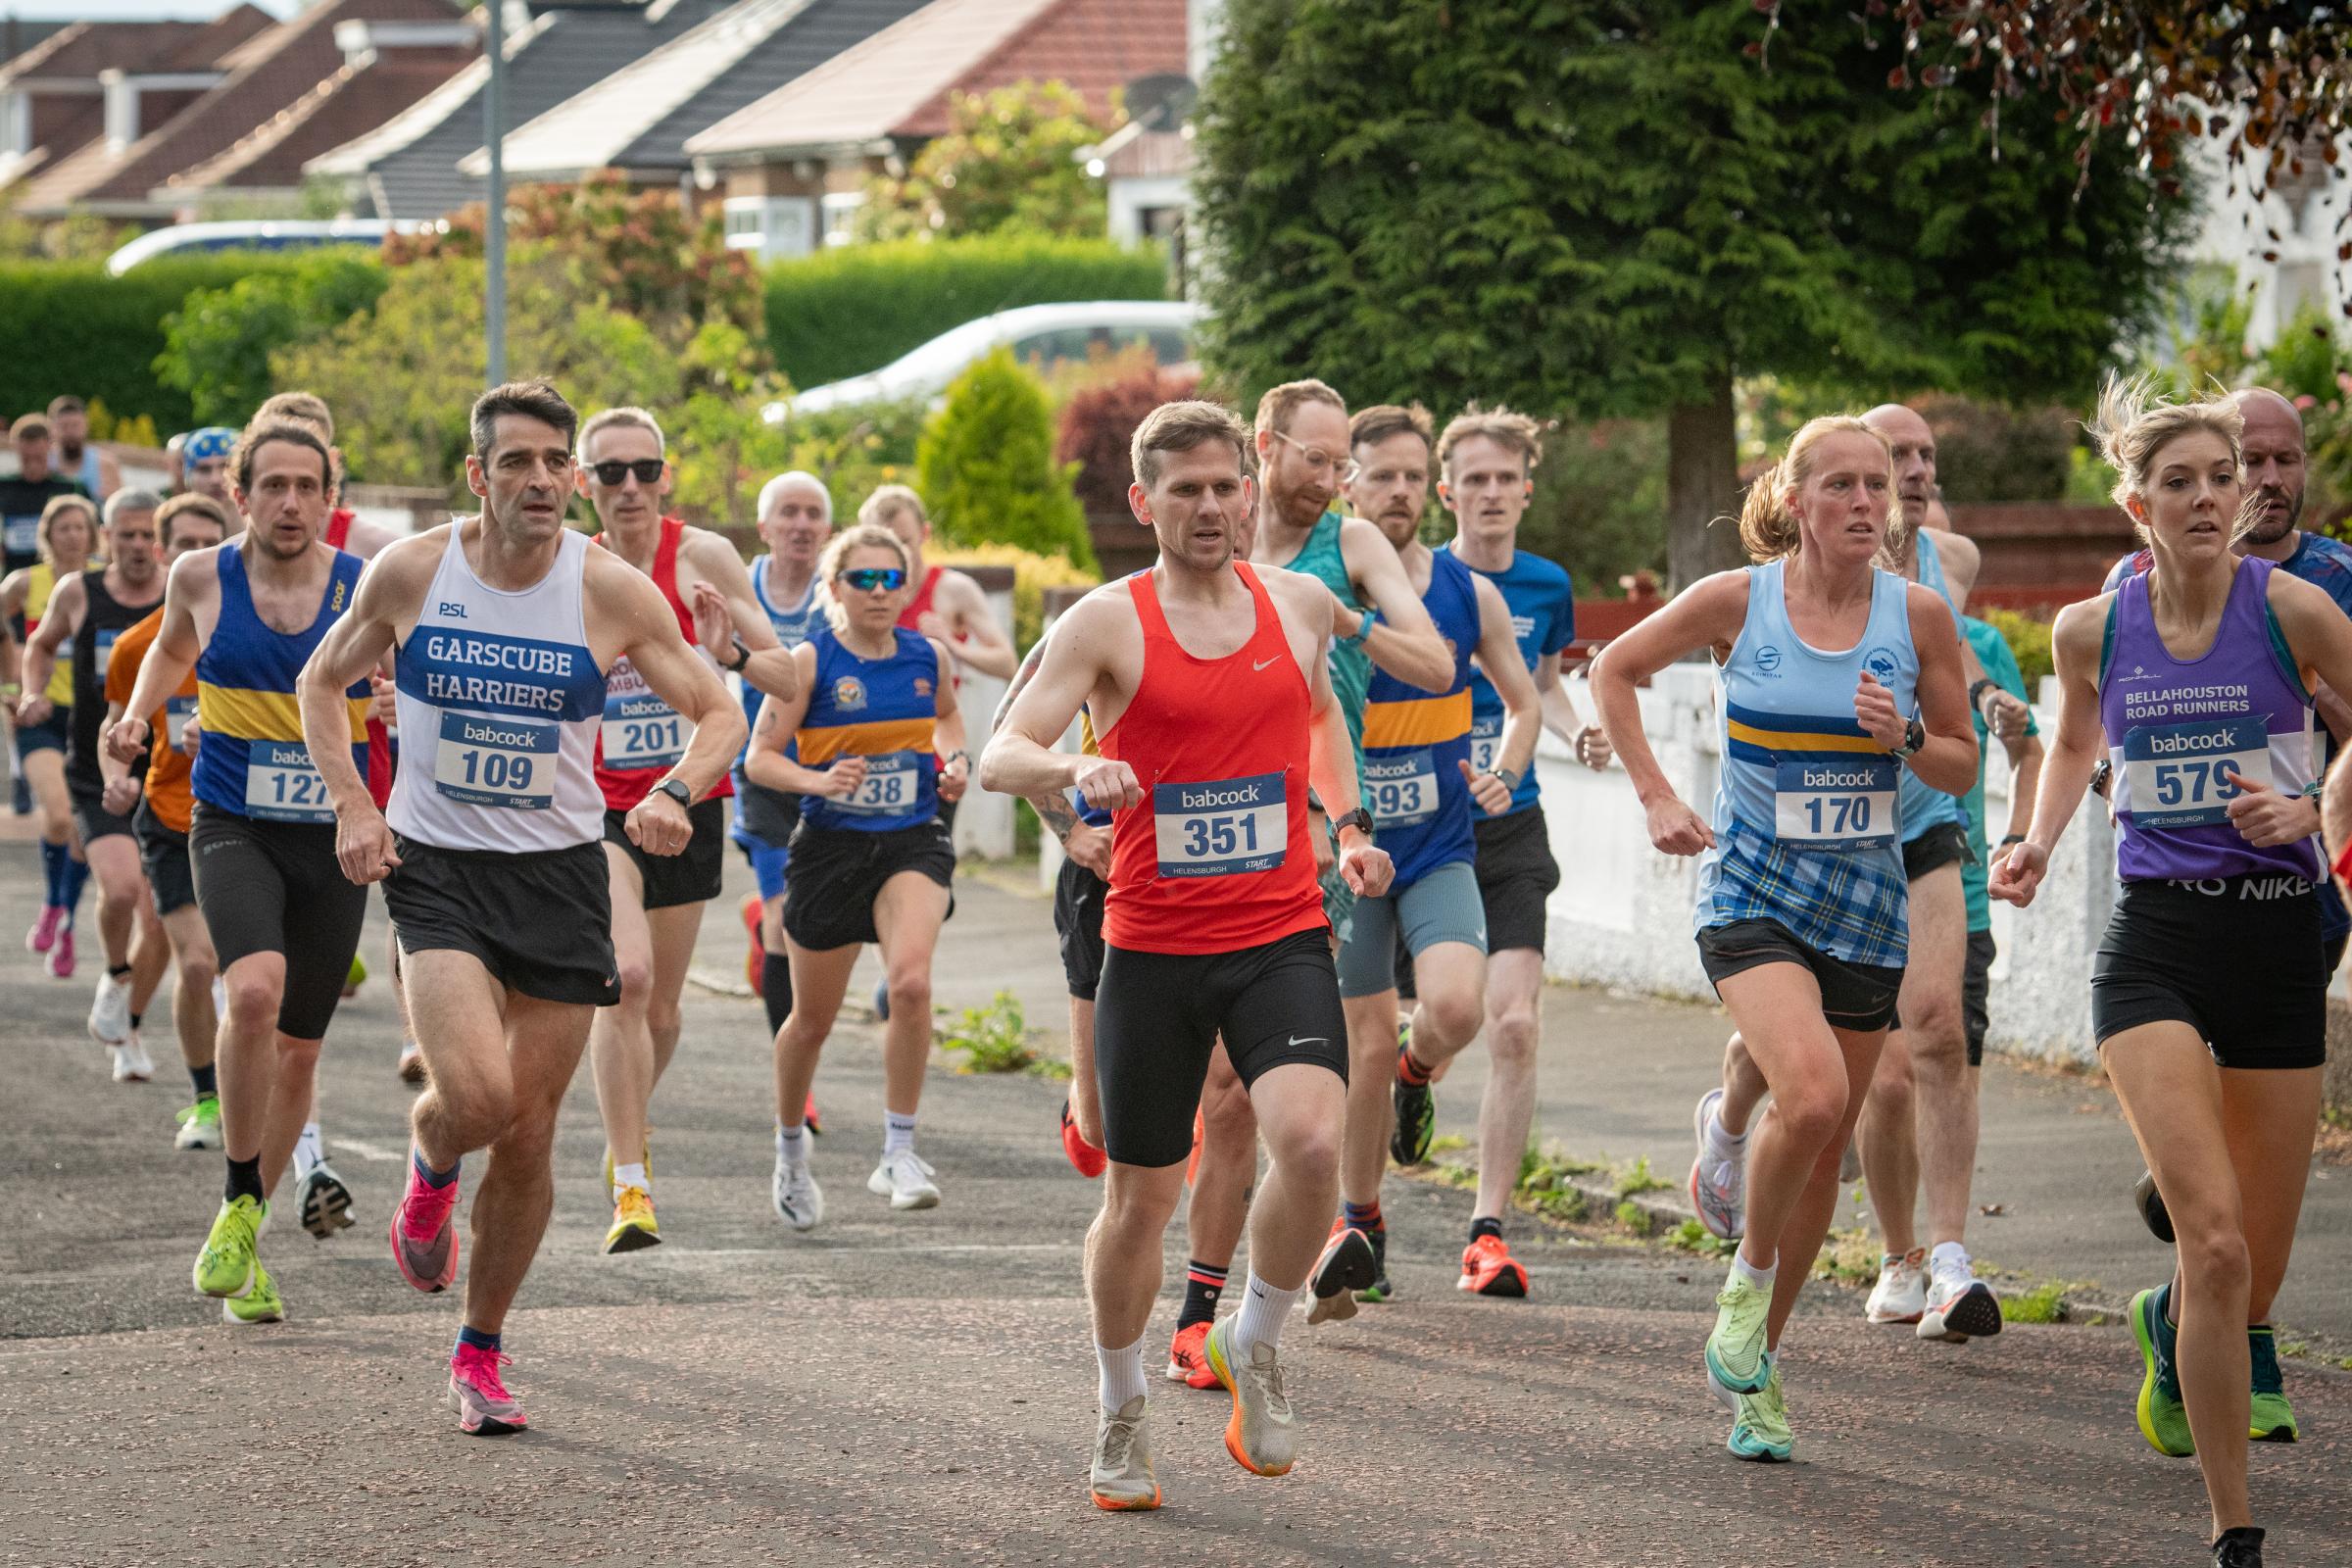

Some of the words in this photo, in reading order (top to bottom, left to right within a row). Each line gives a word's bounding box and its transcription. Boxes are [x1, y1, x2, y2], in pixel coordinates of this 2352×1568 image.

[330, 579, 346, 612] soar
[439, 602, 468, 618] PSL
[427, 636, 572, 677] GARSCUBE
[426, 672, 565, 712] HARRIERS
[2126, 685, 2248, 705] BELLAHOUSTON
[620, 700, 674, 716] babco
[2126, 705, 2169, 720] ROAD
[2173, 700, 2250, 715] RUNNERS
[464, 722, 535, 748] babcock
[624, 718, 679, 753] 201
[2150, 728, 2236, 754] babcock
[271, 748, 315, 765] babc
[462, 750, 533, 790] 109
[1804, 768, 1875, 787] babcock
[2156, 759, 2242, 806] 579
[271, 772, 327, 805] 127
[1182, 784, 1259, 808] babcock
[1804, 796, 1871, 834] 170
[2147, 815, 2205, 826] HELENSBURGH
[1184, 812, 1257, 858] 351
[1173, 865, 1227, 875] HELENSBURGH
[1245, 858, 1270, 869] START
